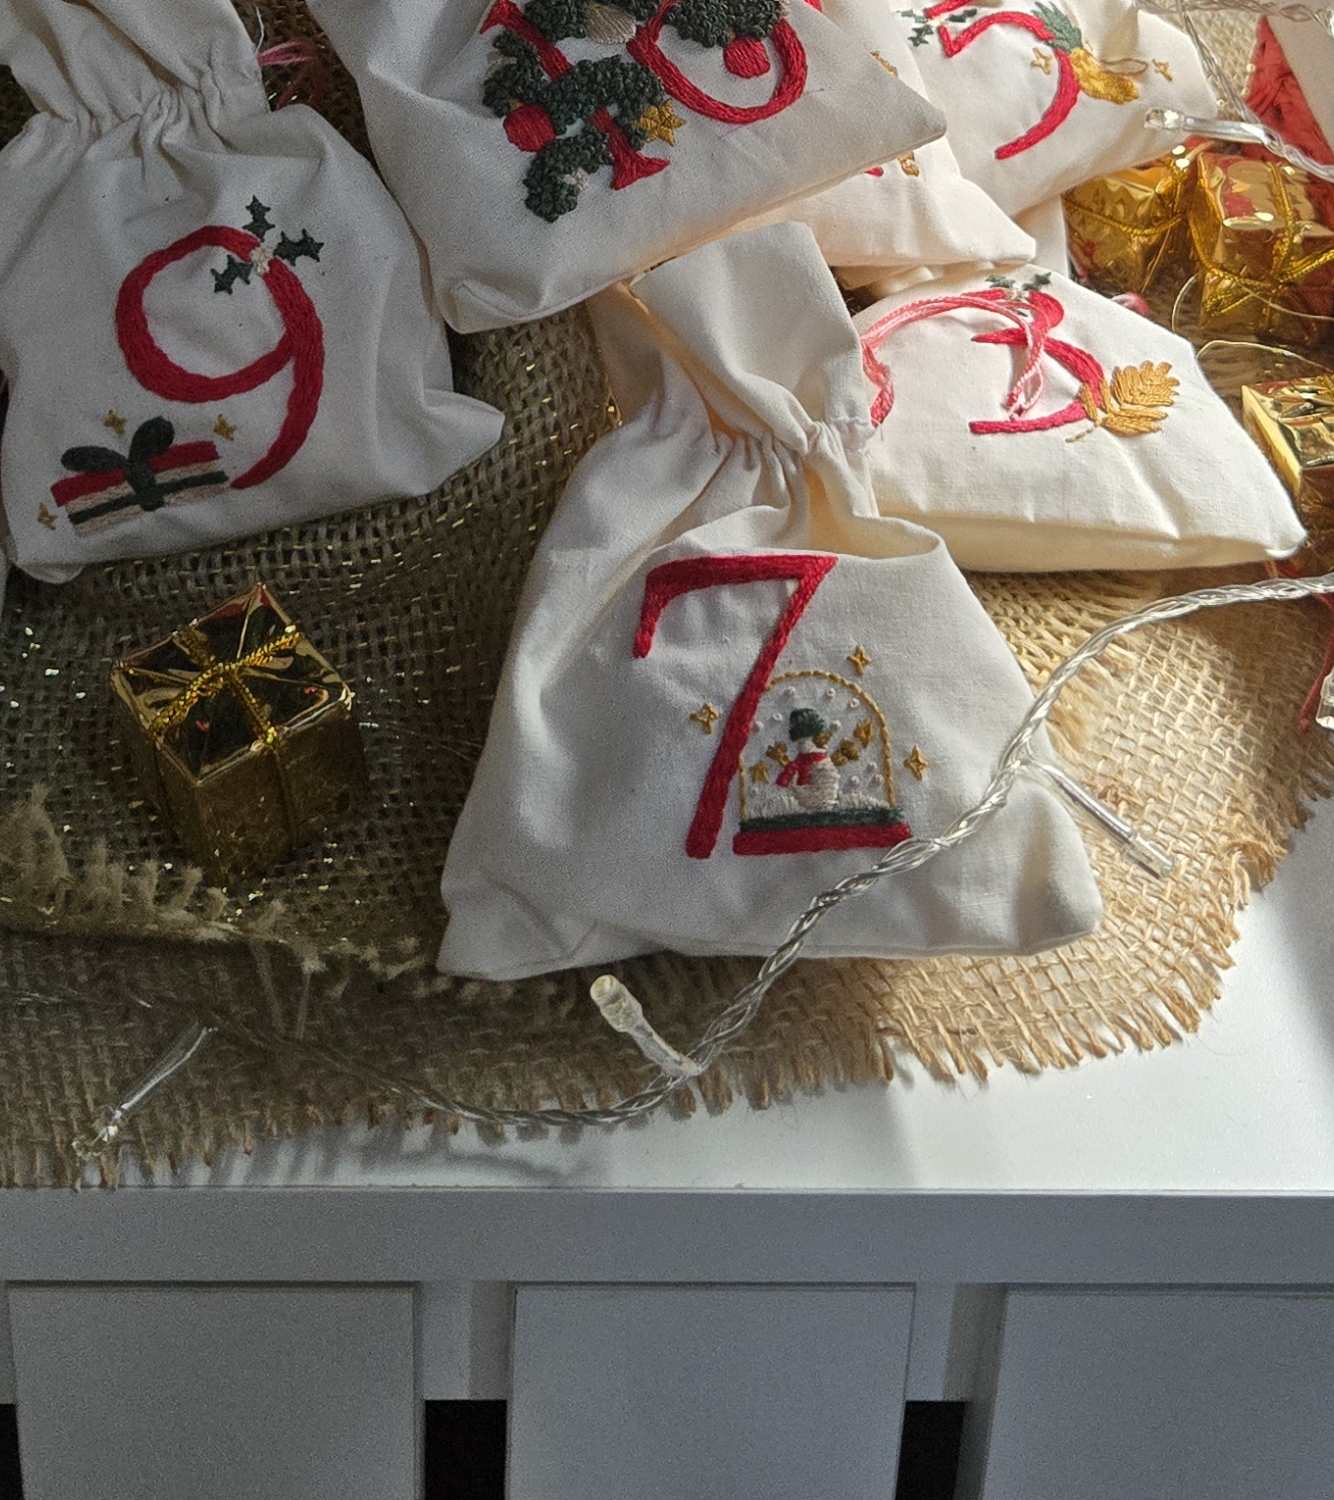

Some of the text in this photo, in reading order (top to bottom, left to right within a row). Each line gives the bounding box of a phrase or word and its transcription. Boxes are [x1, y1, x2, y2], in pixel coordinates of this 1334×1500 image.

[116, 224, 326, 490] 9
[968, 287, 1103, 434] 3
[632, 555, 838, 860] 7
